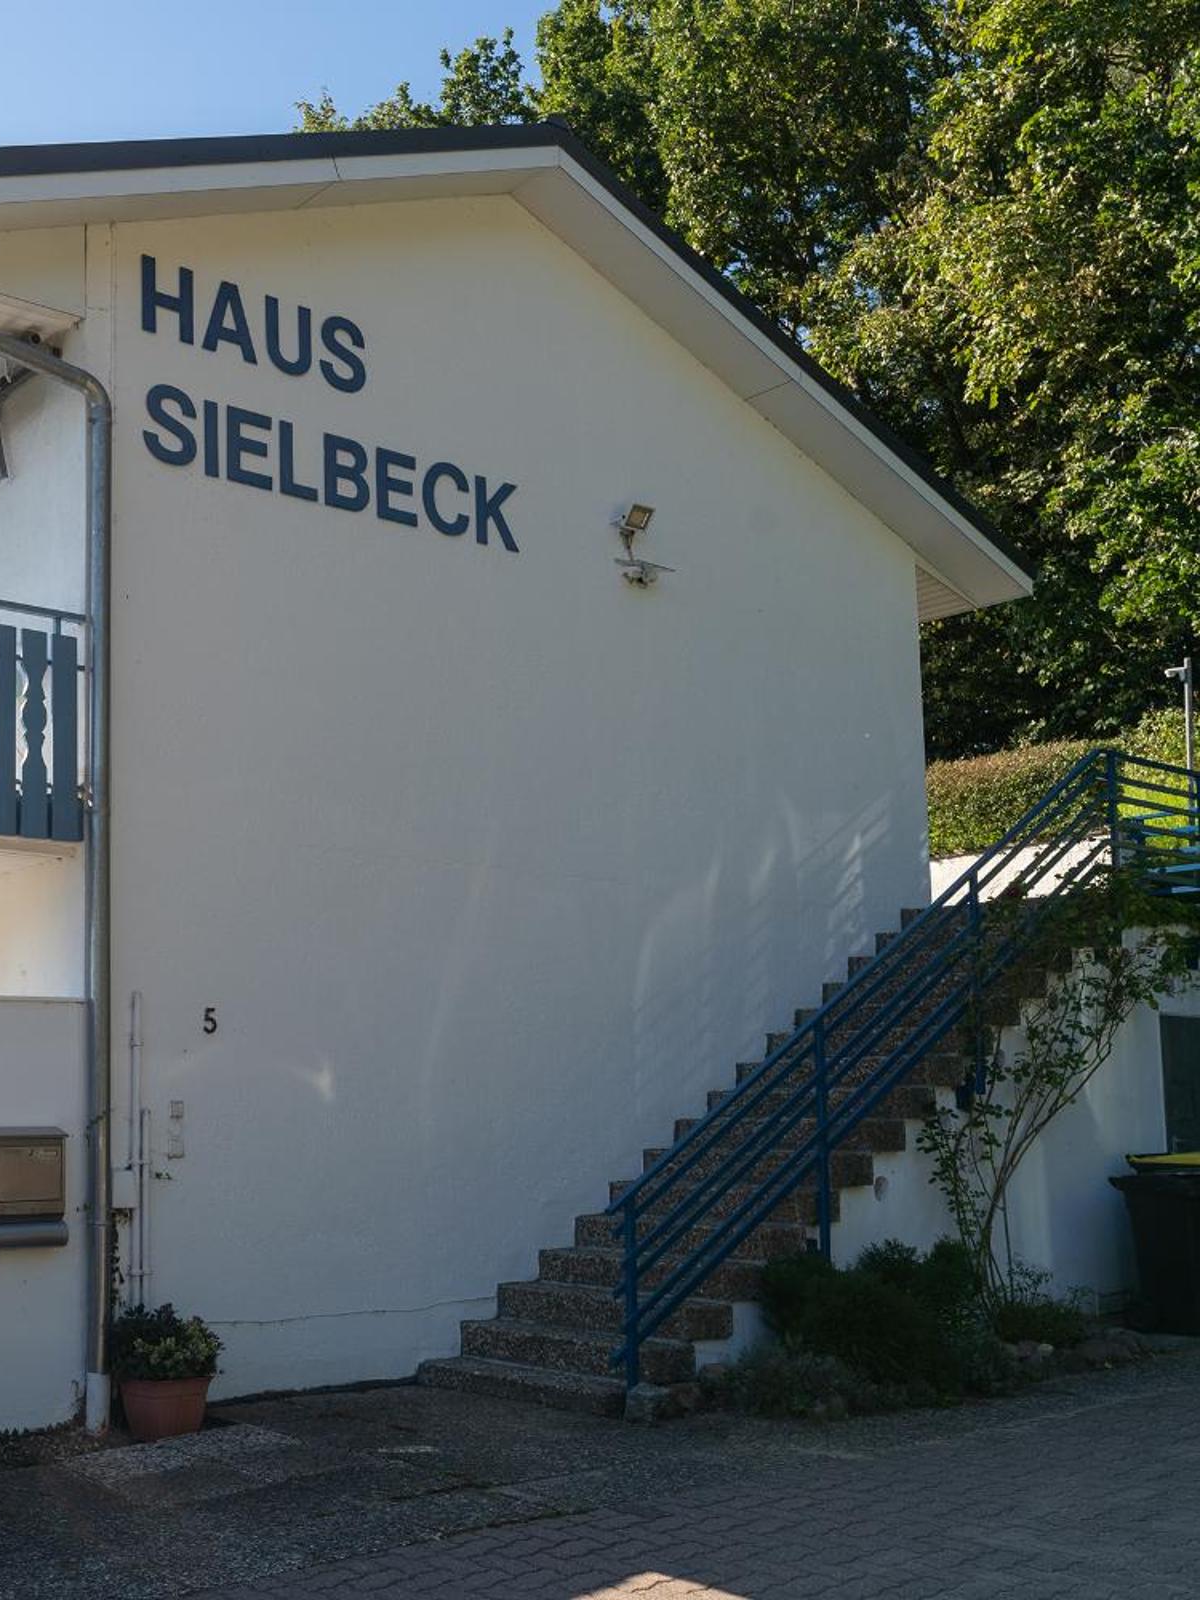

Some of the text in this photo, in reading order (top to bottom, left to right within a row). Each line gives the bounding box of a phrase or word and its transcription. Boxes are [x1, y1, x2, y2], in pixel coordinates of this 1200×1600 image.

[140, 253, 367, 394] HAUS
[142, 383, 520, 554] SIELBECK
[203, 1007, 217, 1034] 5
